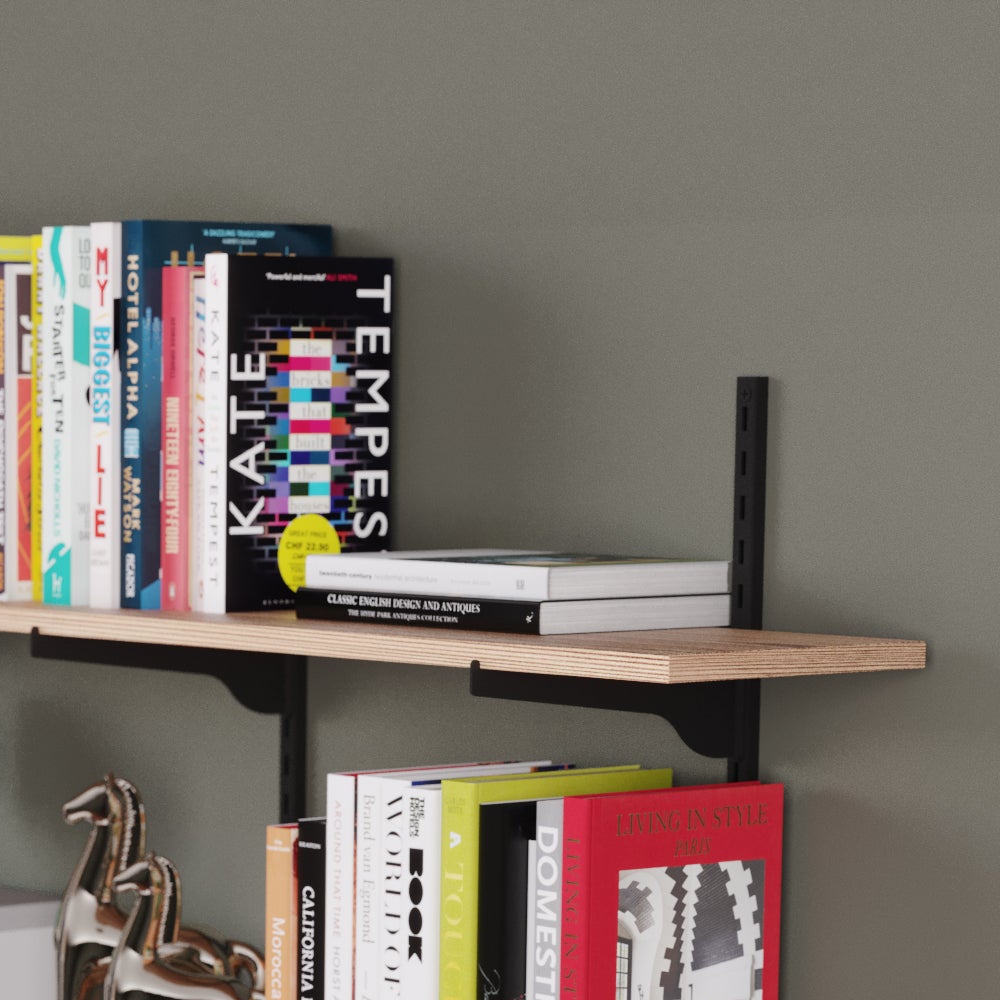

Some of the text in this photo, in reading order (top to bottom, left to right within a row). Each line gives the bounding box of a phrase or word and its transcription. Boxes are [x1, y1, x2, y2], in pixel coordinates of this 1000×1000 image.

[52, 305, 67, 382] STARTER
[127, 254, 139, 420] HOTEL ALPHA
[301, 340, 322, 352] the
[93, 325, 111, 426] BIGGEST
[291, 373, 331, 387] bricks
[53, 395, 66, 434] TEN
[301, 404, 327, 418] that
[354, 274, 391, 553] TEMPES
[211, 310, 221, 588] KATE TEMPEST
[230, 352, 268, 536] KATE
[295, 435, 325, 449] built
[166, 397, 181, 555] NINETEEN EIGHTY-FOUR
[296, 466, 318, 480] the
[123, 465, 133, 543] WATSON
[132, 477, 141, 531] MARK
[285, 541, 303, 550] CHF
[327, 593, 481, 615] CLASSIC ENGLISH DESIGN AND ANTIQUES
[347, 609, 359, 617] THE
[376, 611, 391, 619] PARK
[333, 800, 344, 864] AROUND
[363, 795, 377, 842] Brand
[449, 831, 462, 849] A
[615, 803, 769, 837] LIVING IN STYLE
[363, 845, 373, 873] van
[385, 795, 404, 936] WORLD
[673, 837, 712, 858] PARIS
[333, 868, 344, 900] THAT
[564, 837, 582, 925] LIVING
[332, 904, 343, 937] TIME
[360, 880, 377, 944] Egmond
[409, 848, 424, 964] BOOK
[301, 885, 316, 993] CALIFORNIA
[563, 931, 579, 961] IN
[332, 945, 343, 991] HORST
